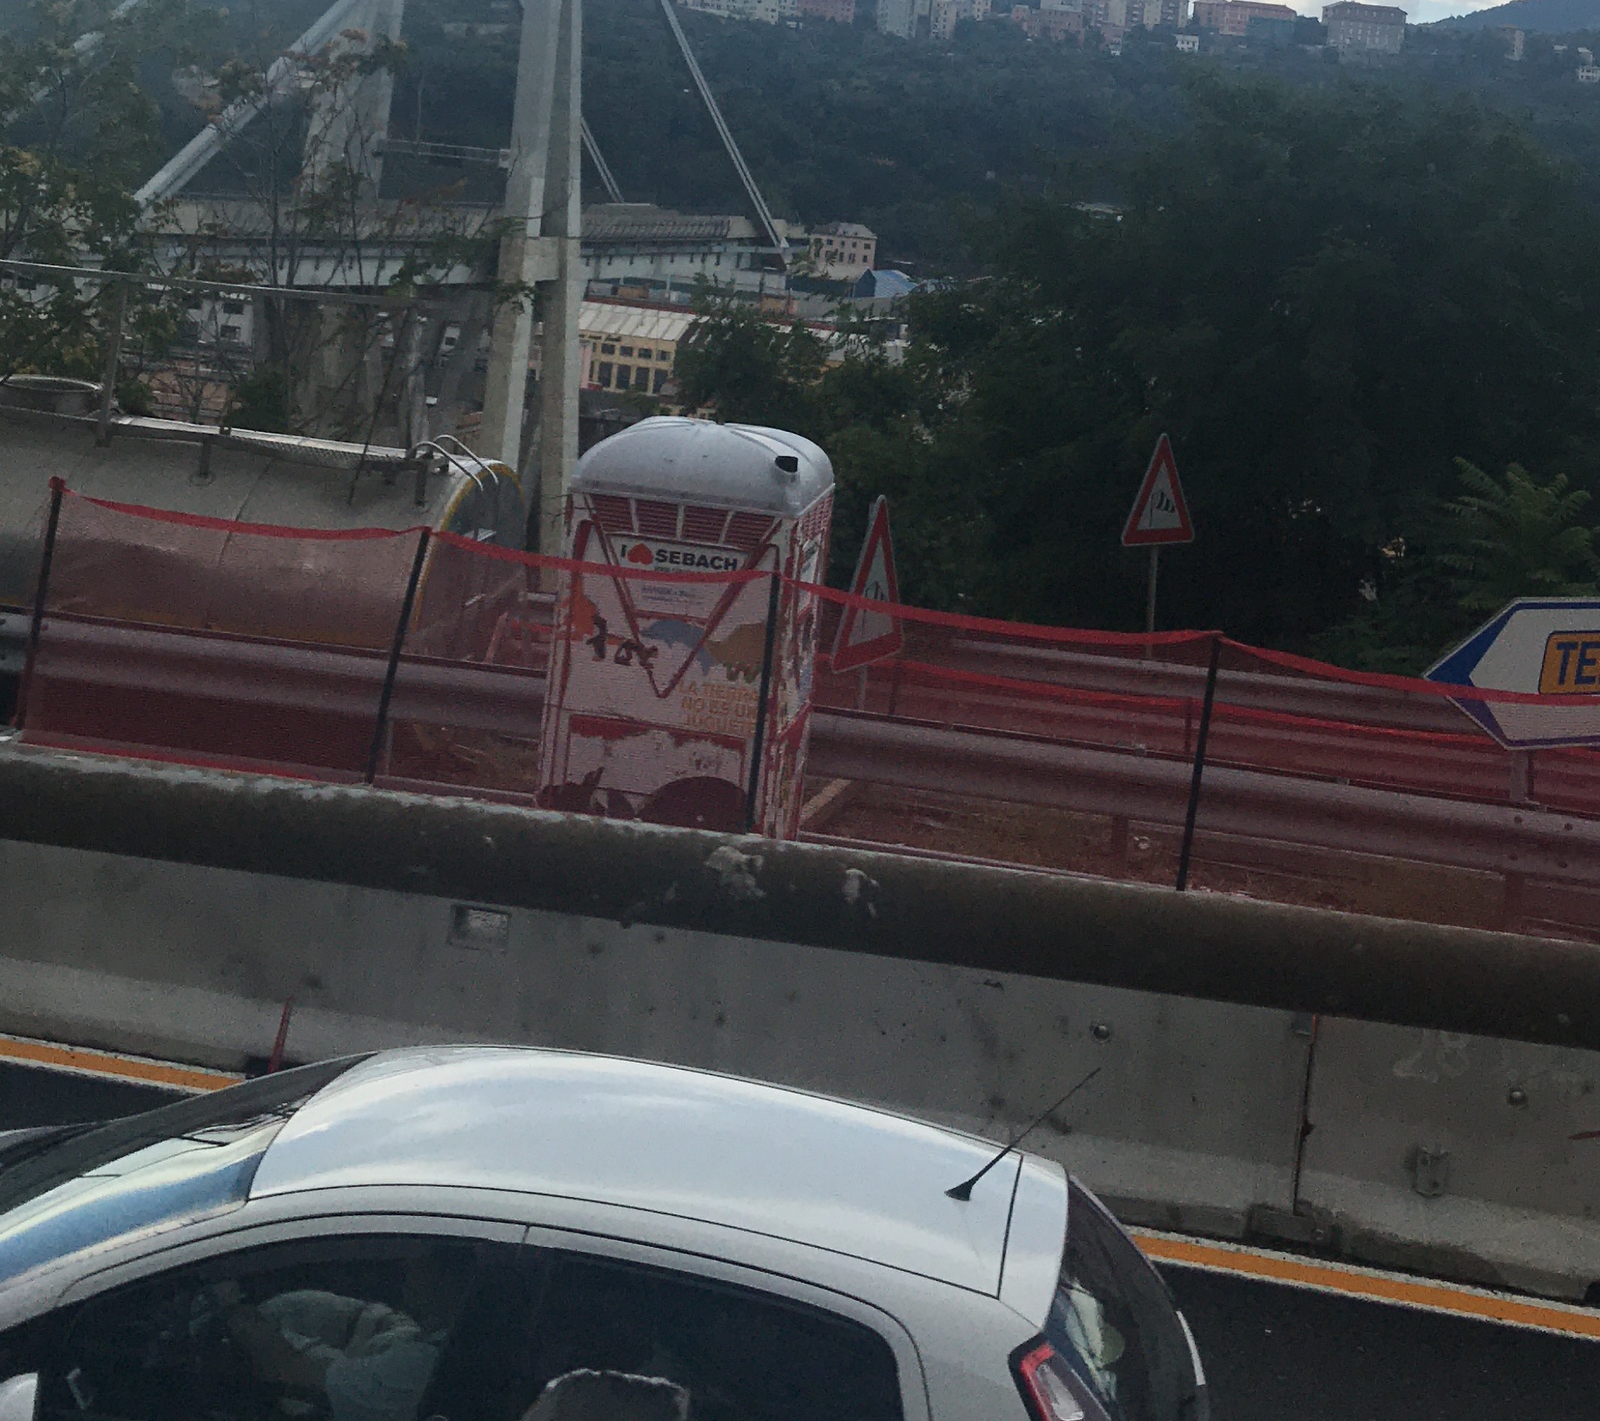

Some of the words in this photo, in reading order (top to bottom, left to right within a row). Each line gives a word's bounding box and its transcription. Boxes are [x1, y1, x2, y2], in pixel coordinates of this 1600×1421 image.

[620, 543, 627, 557] I
[654, 548, 738, 570] SEBACH
[1556, 641, 1600, 685] TE
[681, 695, 704, 713] NO
